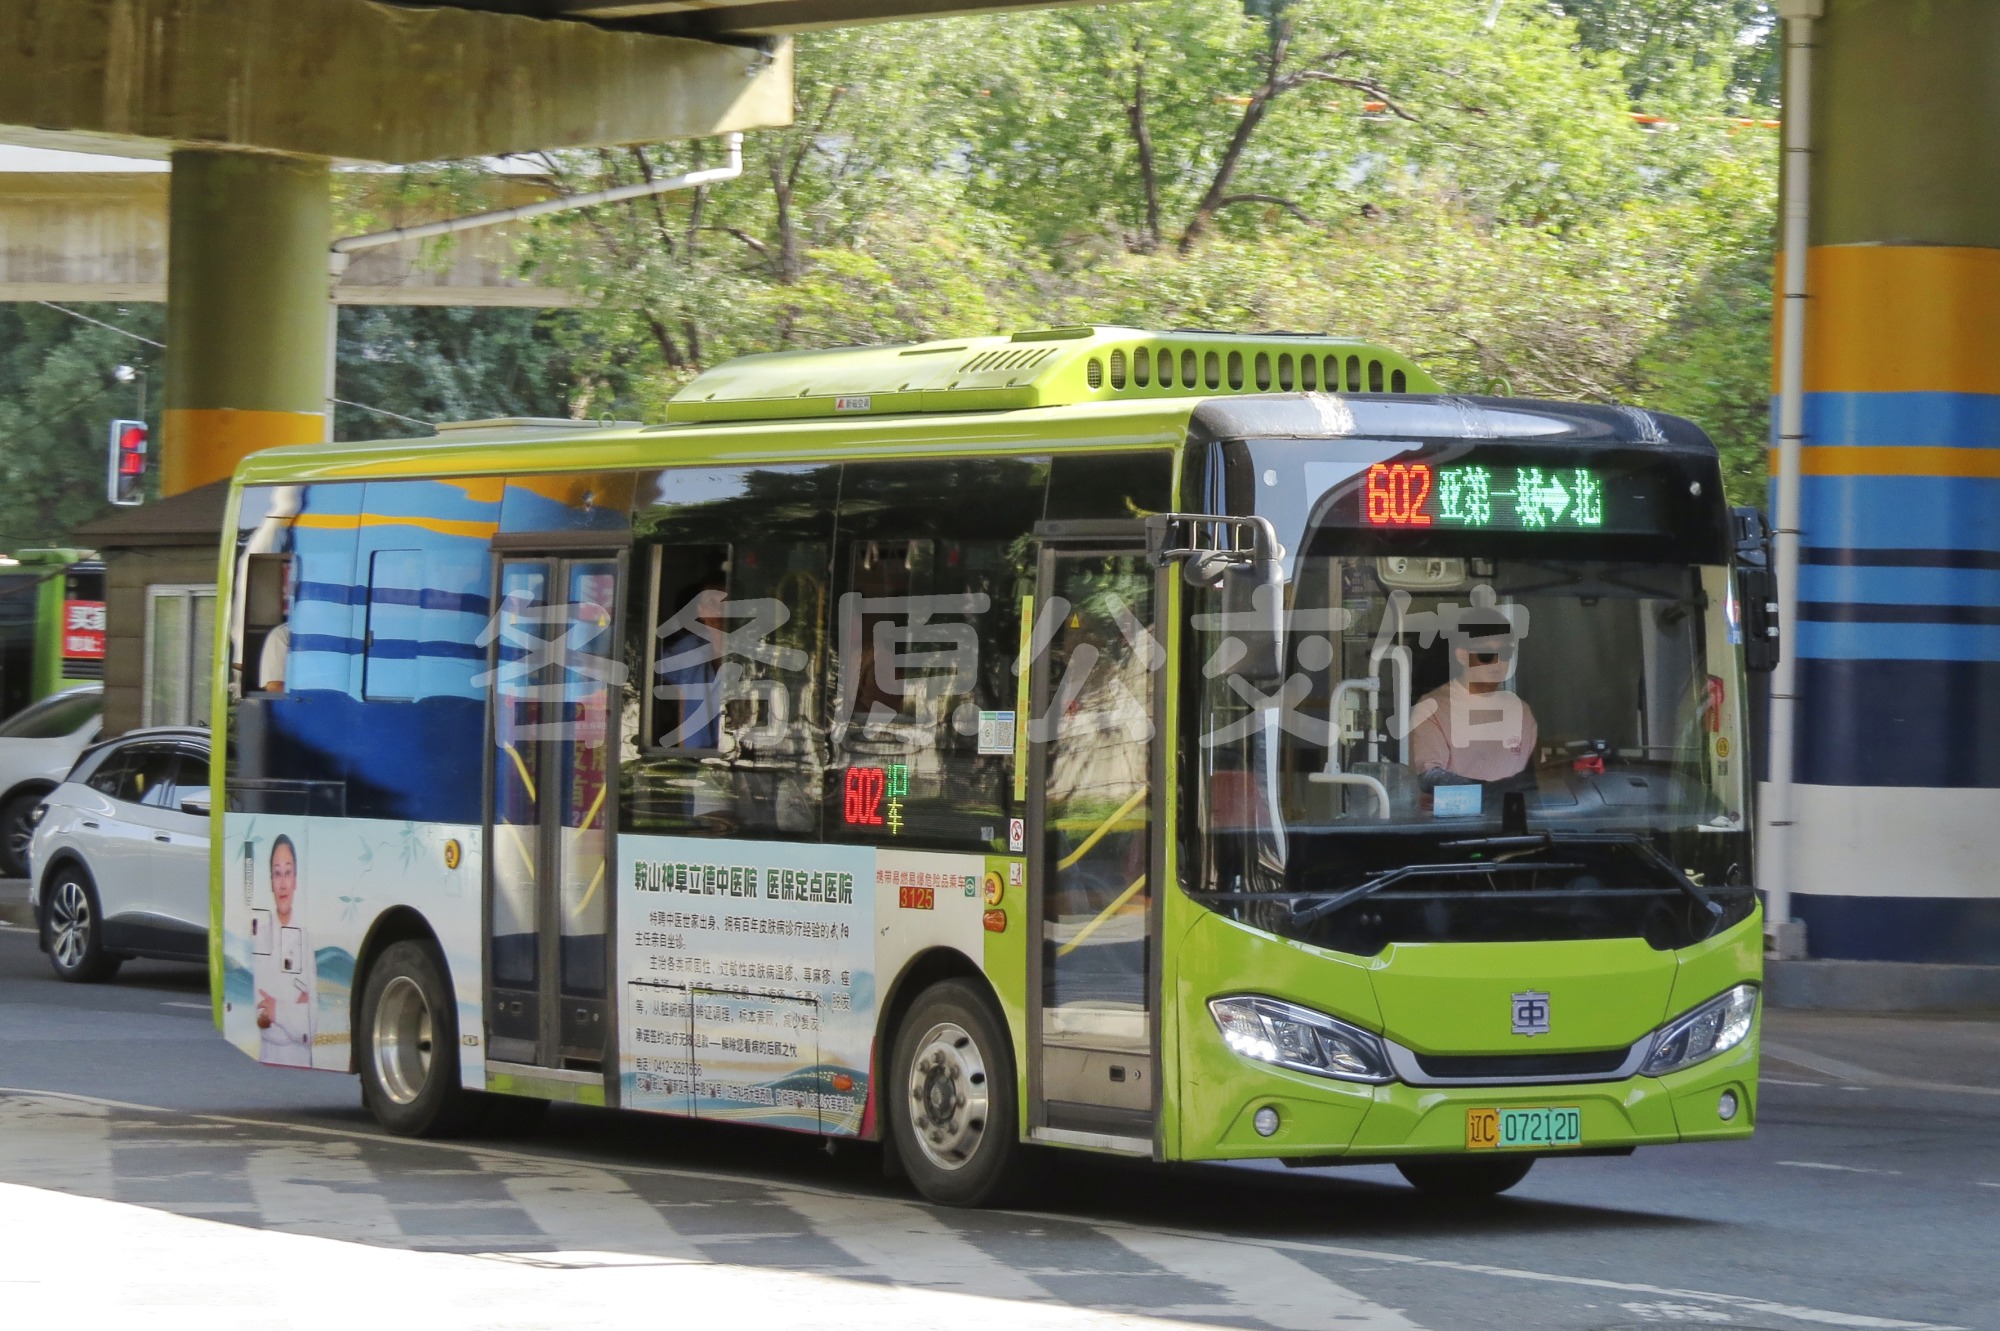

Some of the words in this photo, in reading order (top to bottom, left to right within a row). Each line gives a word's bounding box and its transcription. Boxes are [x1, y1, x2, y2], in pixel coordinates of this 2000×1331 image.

[1368, 463, 1431, 525] 602
[845, 766, 884, 824] 602
[634, 860, 758, 898] 鞍山神草立德中医院
[766, 868, 853, 904] 医保定点医院
[901, 887, 933, 909] 3125
[1470, 1114, 1495, 1142] 辽C
[1505, 1112, 1579, 1141] 07212D
